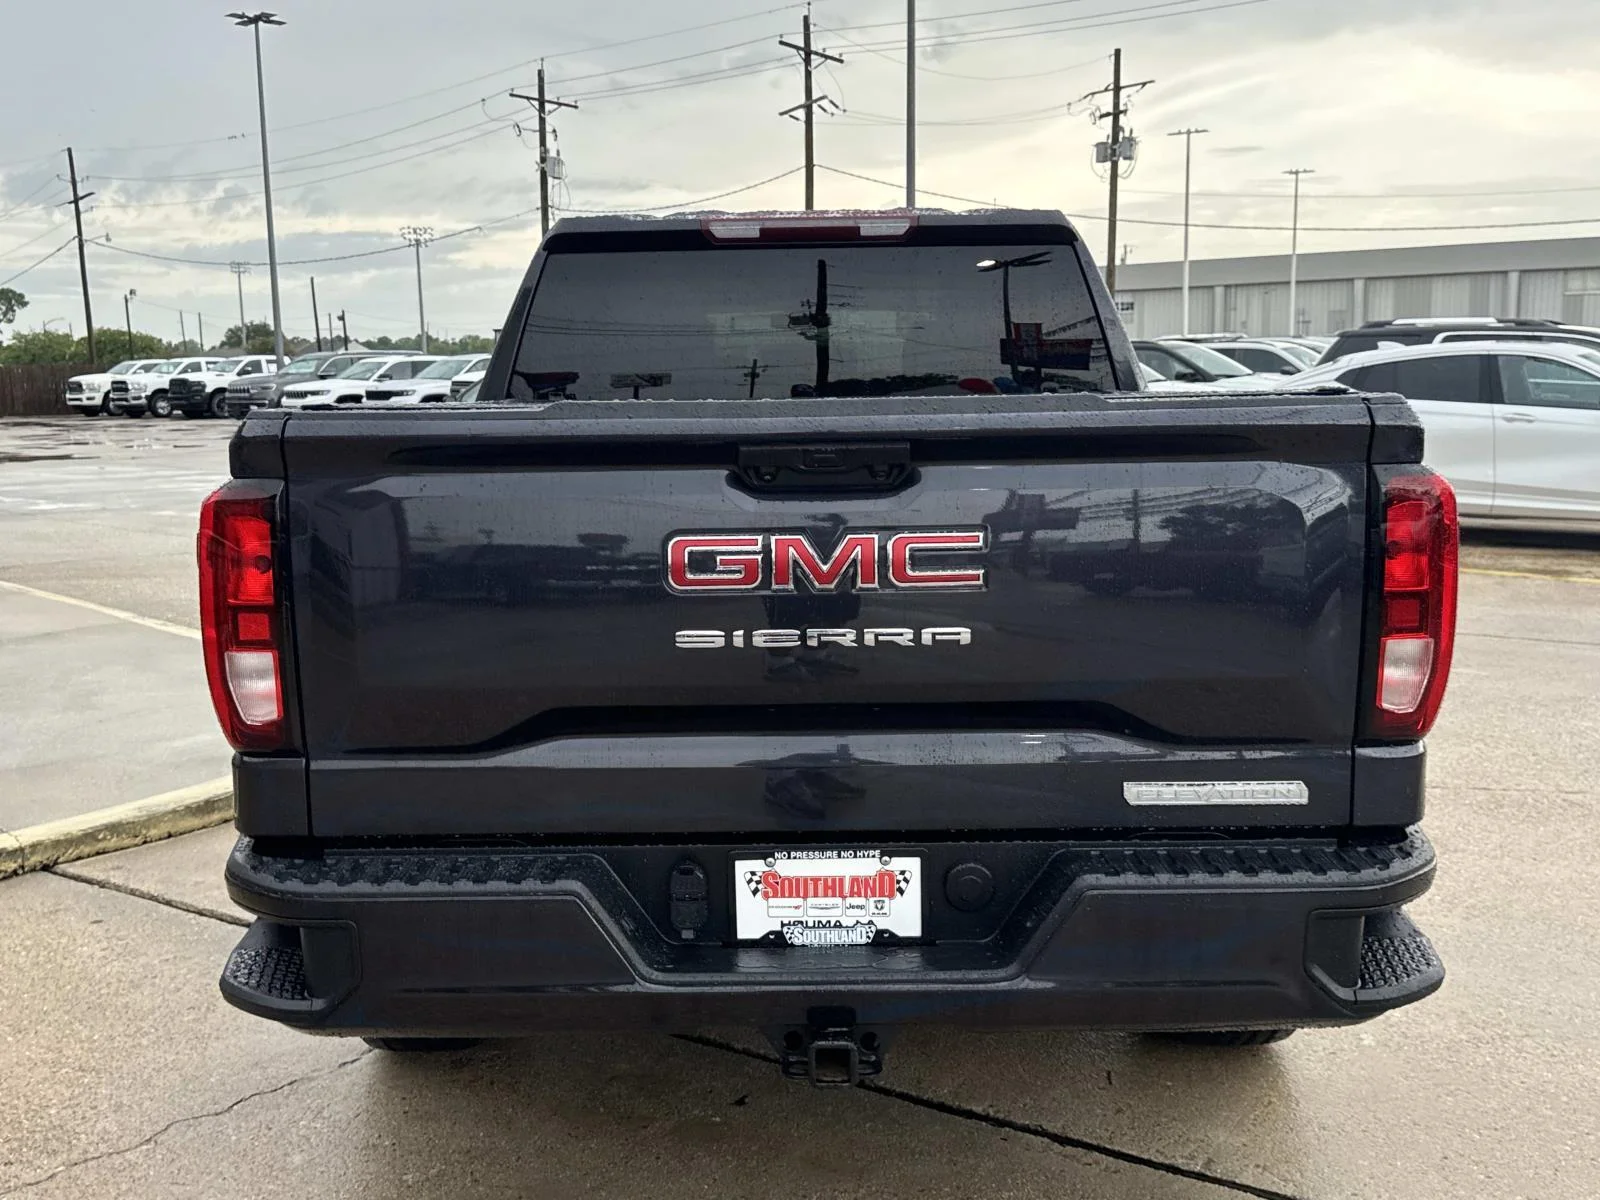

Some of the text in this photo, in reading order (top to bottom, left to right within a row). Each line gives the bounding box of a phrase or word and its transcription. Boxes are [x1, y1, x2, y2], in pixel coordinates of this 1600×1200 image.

[668, 532, 985, 589] GMC
[675, 627, 972, 648] SIERRA
[1135, 785, 1303, 802] ELEVATION
[774, 850, 881, 859] NO PRESSURE NO HYPE
[846, 903, 865, 911] Jeep
